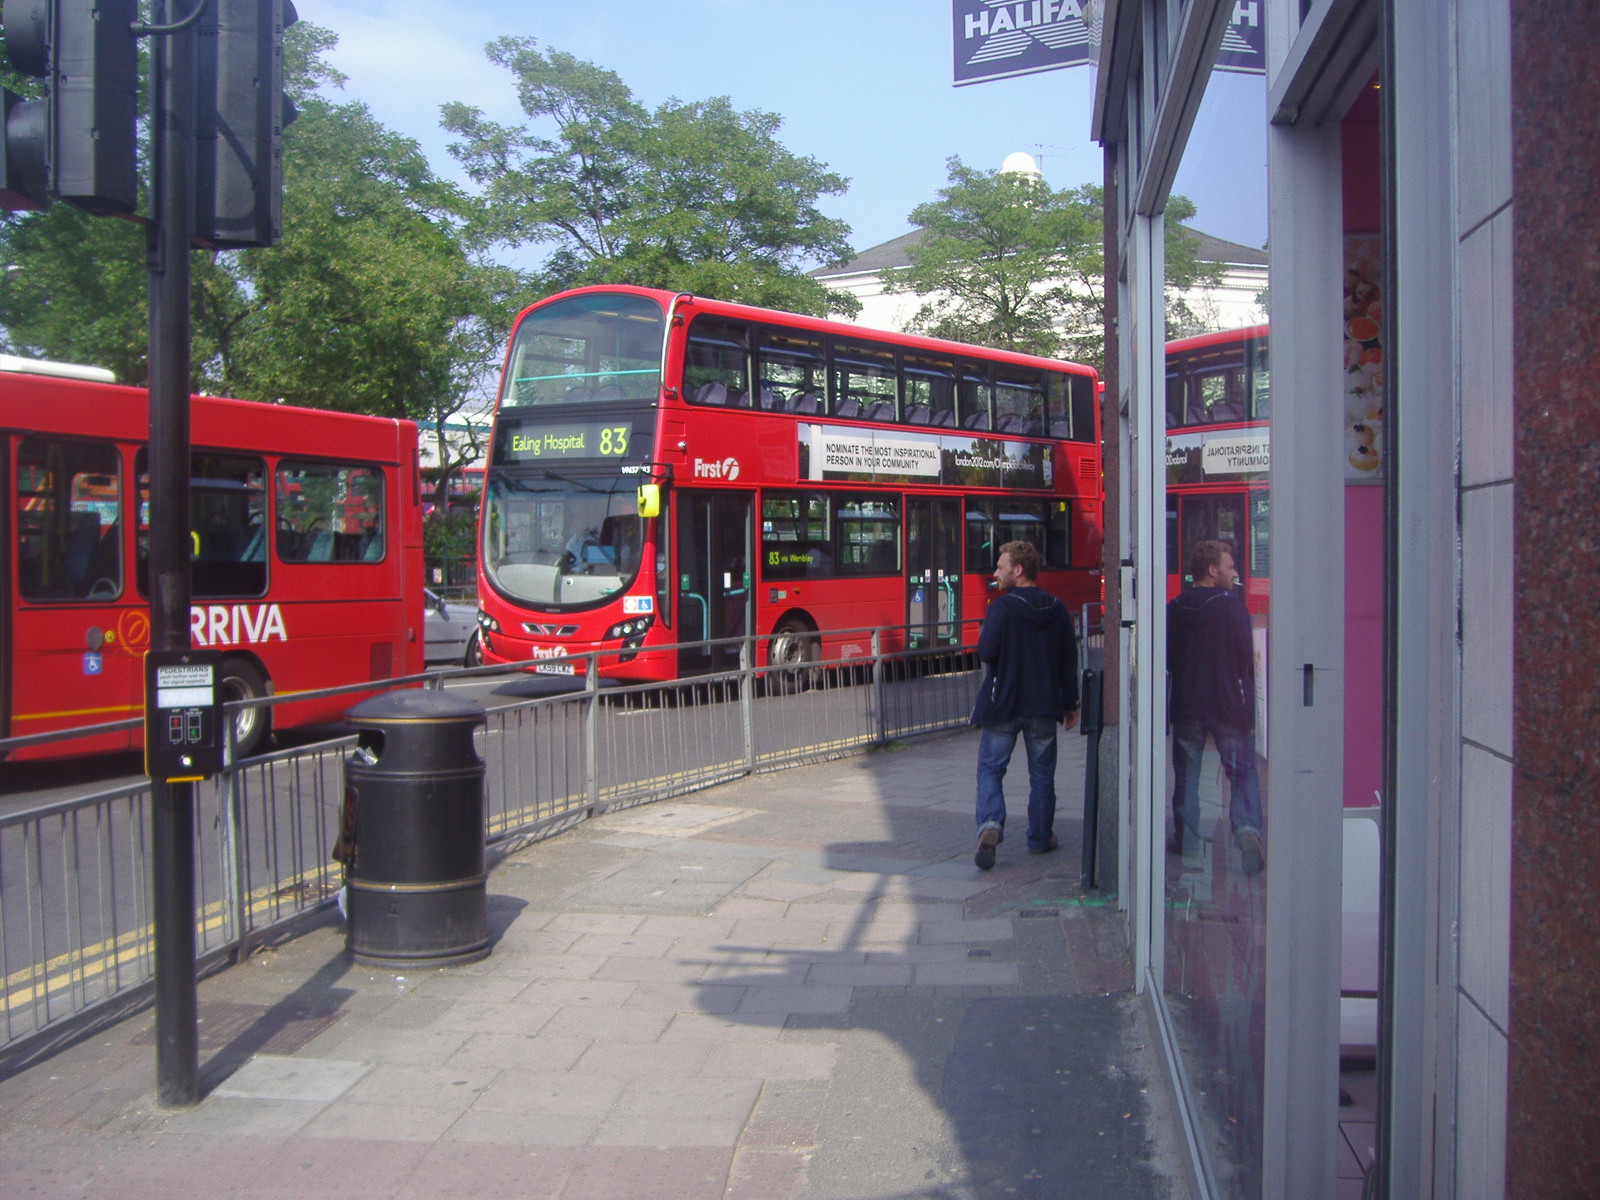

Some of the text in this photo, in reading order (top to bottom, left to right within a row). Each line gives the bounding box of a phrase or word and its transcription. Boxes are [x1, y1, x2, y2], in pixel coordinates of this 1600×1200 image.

[964, 0, 1082, 39] HALIFA
[512, 427, 628, 456] Ealing Hospital 83
[826, 443, 936, 460] NOMINATE THE MOST INSPIRATIONAL
[694, 458, 721, 478] First
[826, 455, 919, 470] PERSON IN YOUR COMMUNITY
[768, 551, 780, 566] 83
[190, 603, 288, 646] RRIVA
[532, 645, 553, 659] First
[159, 664, 209, 674] PEDESTRIANS
